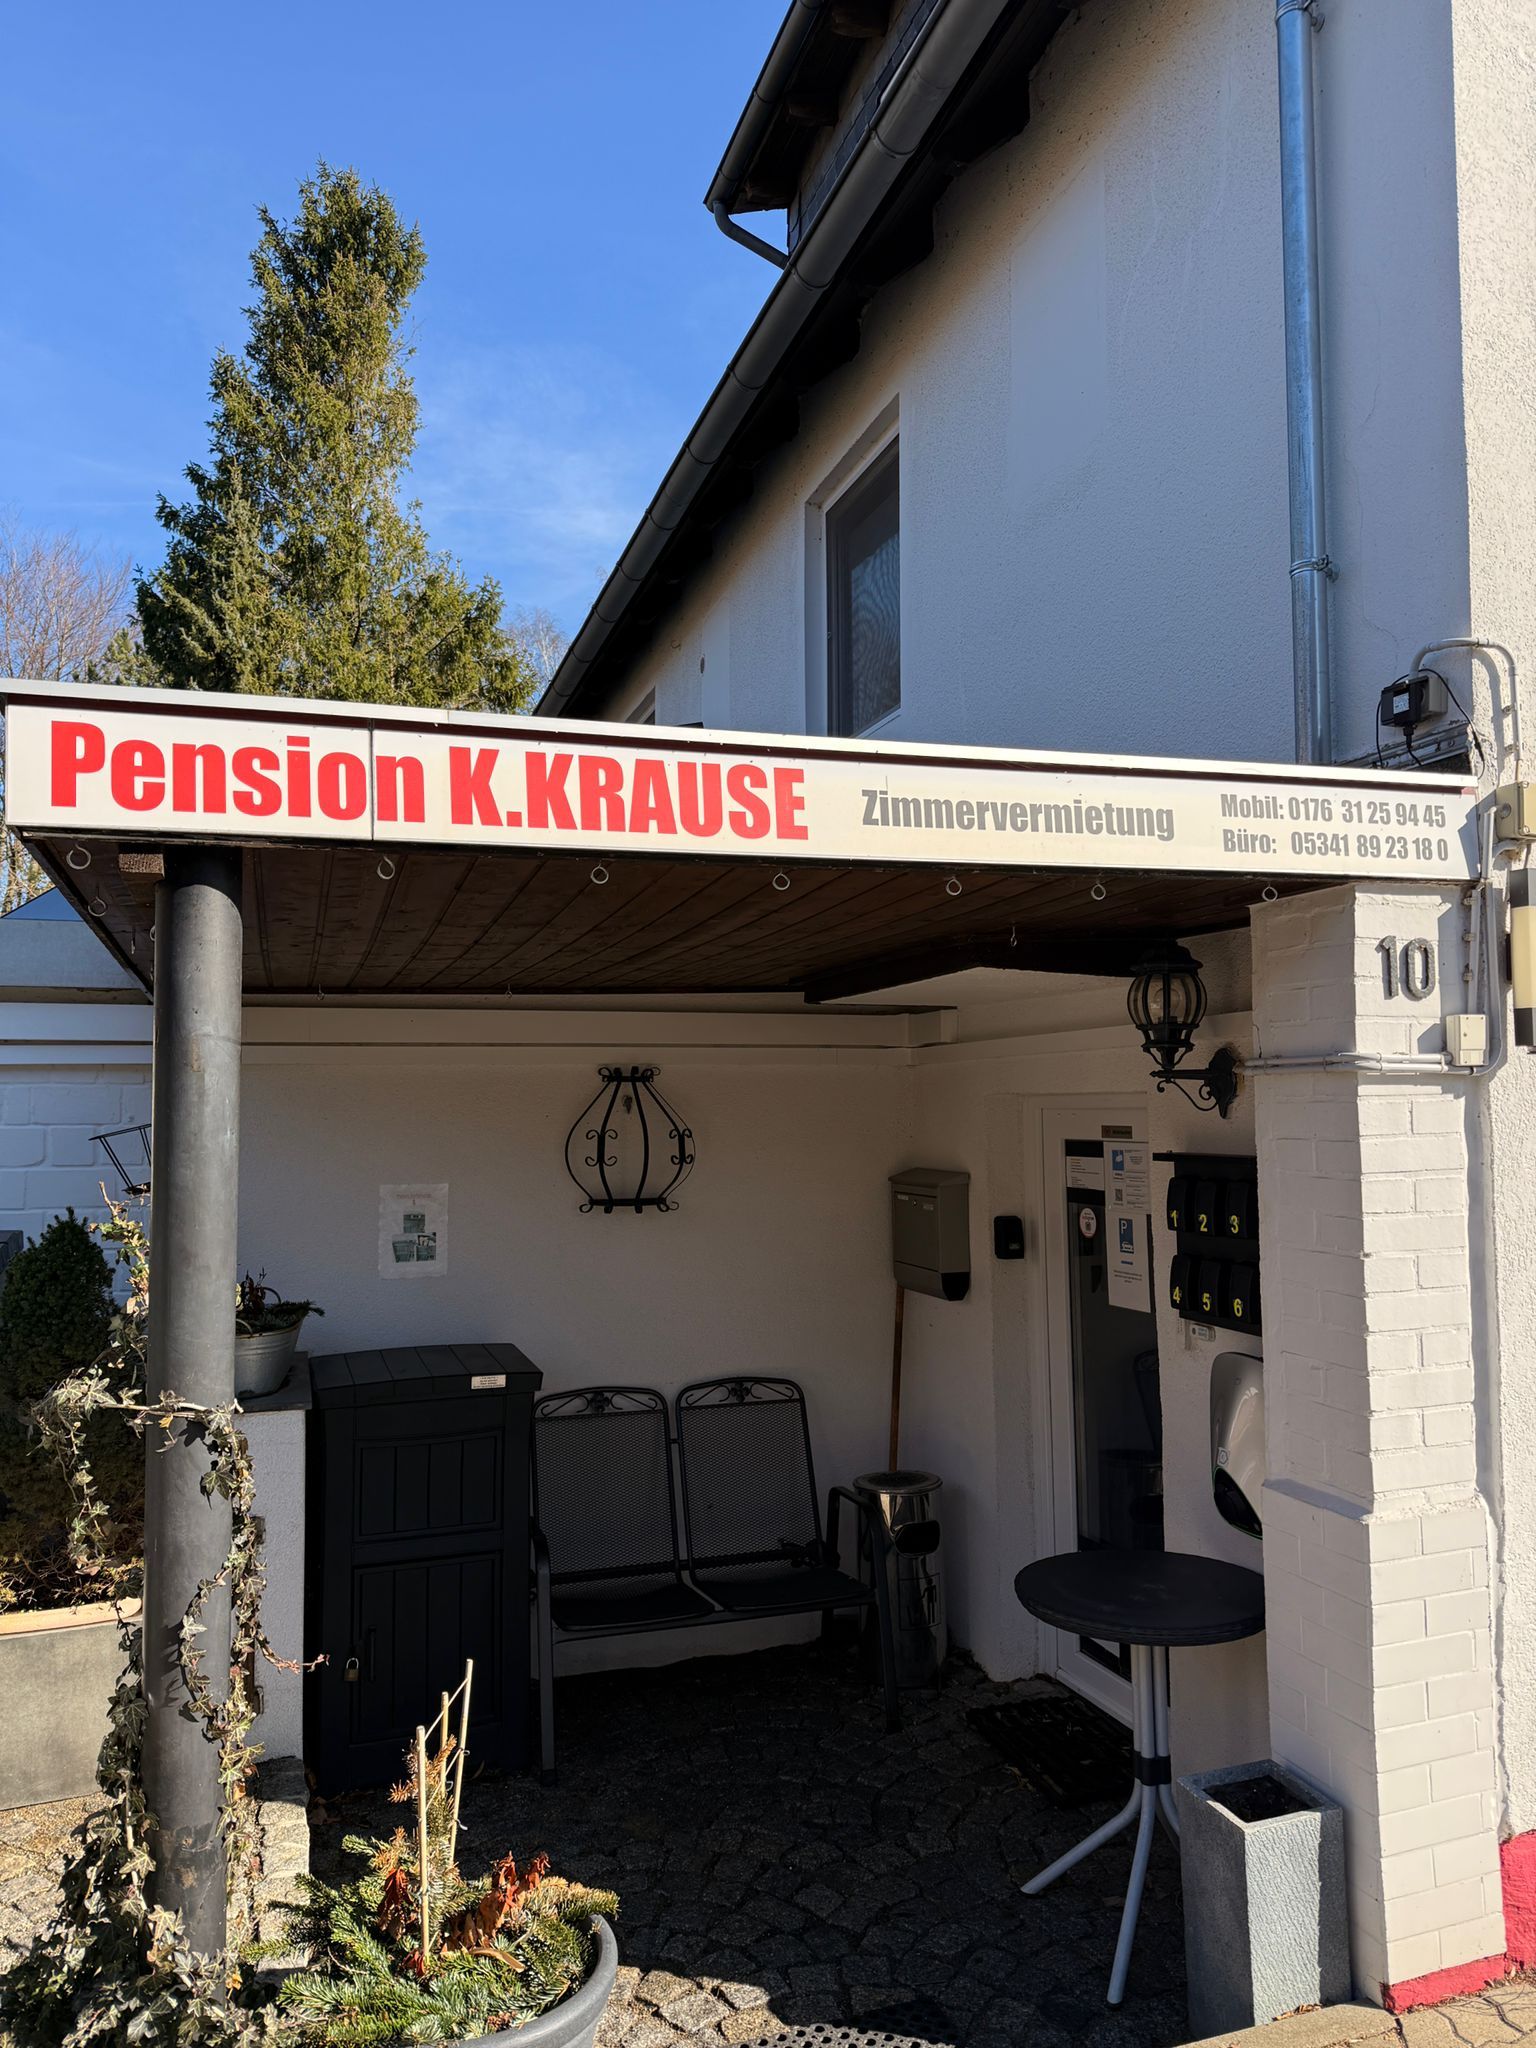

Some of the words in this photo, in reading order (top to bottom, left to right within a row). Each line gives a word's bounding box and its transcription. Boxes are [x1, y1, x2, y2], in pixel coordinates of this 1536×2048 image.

[51, 720, 426, 823] Pension
[449, 746, 809, 841] K.KRAUSE
[861, 789, 1175, 842] Zimmervermietung
[1220, 794, 1284, 819] Mobil:
[1288, 797, 1333, 822] 0176
[1341, 800, 1363, 824] 31
[1367, 801, 1391, 825] 25
[1395, 803, 1419, 827] 94
[1423, 805, 1446, 828] 45
[1222, 828, 1277, 854] Büro:
[1291, 831, 1350, 857] 05341
[1357, 835, 1381, 858] 89
[1385, 836, 1408, 860] 23
[1412, 837, 1433, 861] 18
[1437, 838, 1449, 861] 0
[1377, 935, 1436, 1000] 10
[1120, 1220, 1128, 1234] P
[1170, 1210, 1178, 1227] 1
[1199, 1214, 1208, 1232] 2
[1229, 1215, 1239, 1234] 3
[1172, 1286, 1181, 1304] 4
[1202, 1293, 1211, 1311] 5
[1233, 1299, 1242, 1317] 6
